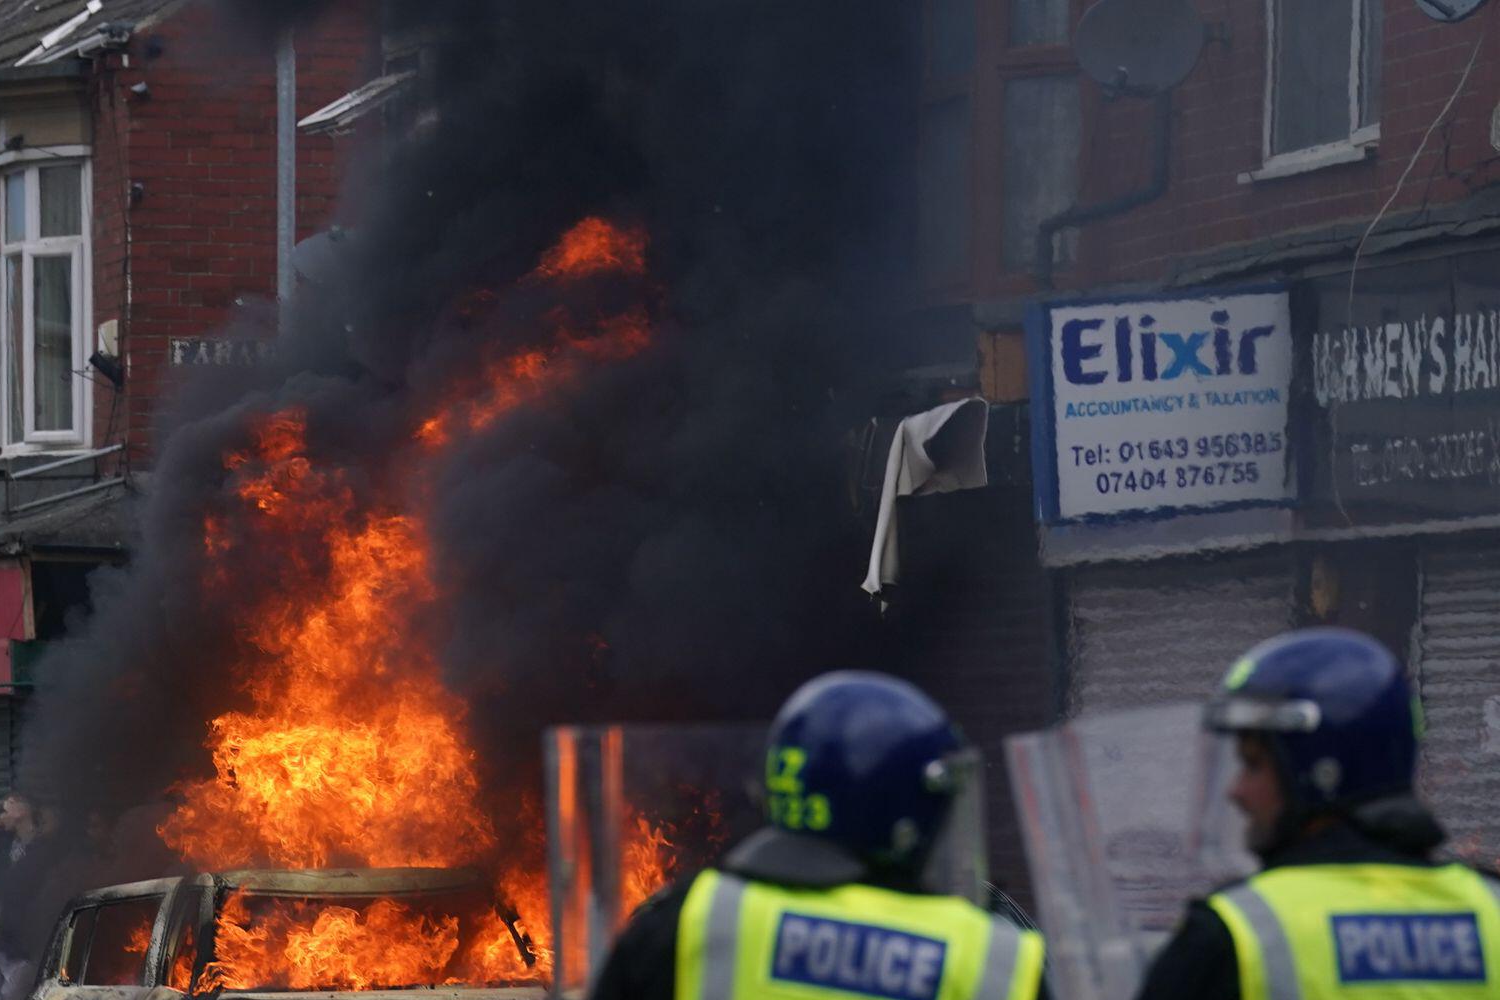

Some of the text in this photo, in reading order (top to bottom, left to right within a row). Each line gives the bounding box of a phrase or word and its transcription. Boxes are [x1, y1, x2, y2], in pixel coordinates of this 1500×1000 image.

[1061, 310, 1275, 385] Elixir
[1363, 312, 1448, 399] MEN'S
[1453, 309, 1500, 392] HAI
[1065, 388, 1281, 419] ACCOUNTANCY & TAXATION
[1072, 445, 1111, 466] Tel:
[1096, 461, 1260, 494] 07404 876755
[779, 913, 942, 1000] POLICE
[1334, 917, 1482, 975] POLICE
